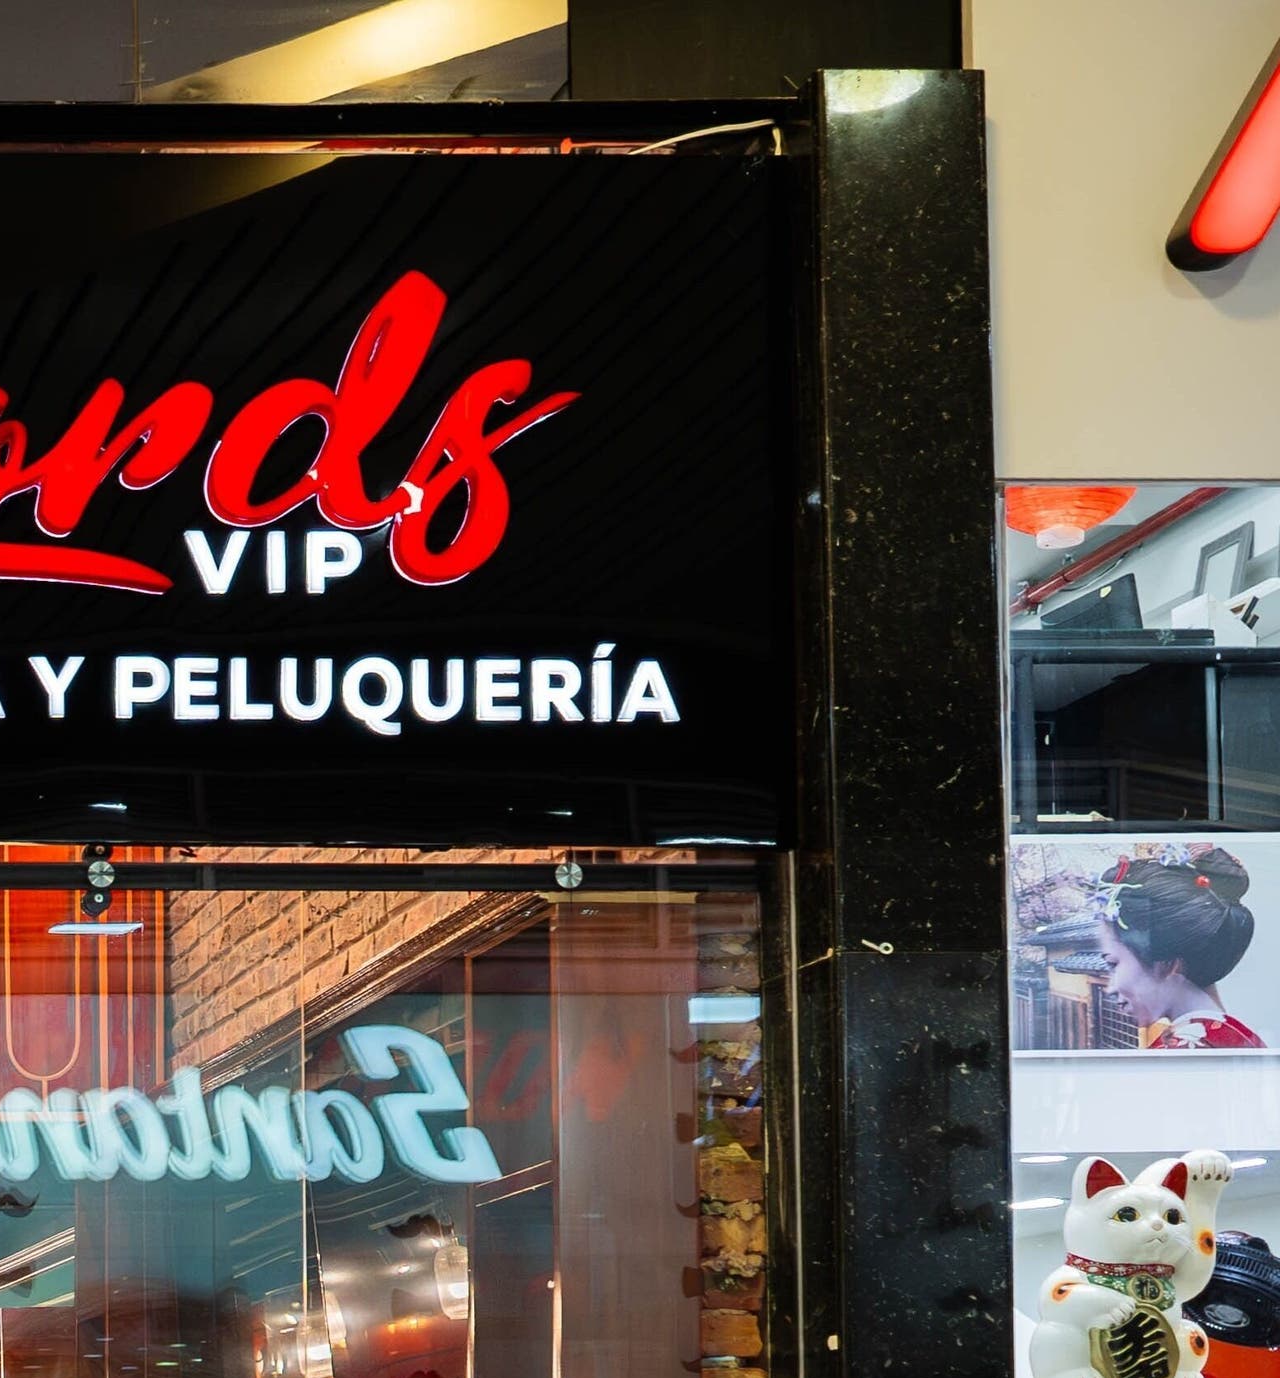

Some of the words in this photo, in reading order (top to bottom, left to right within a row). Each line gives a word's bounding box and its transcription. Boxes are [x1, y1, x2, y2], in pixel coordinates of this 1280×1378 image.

[183, 529, 364, 595] VIP
[28, 655, 86, 720] Y
[113, 643, 682, 737] PELUQUERÍA
